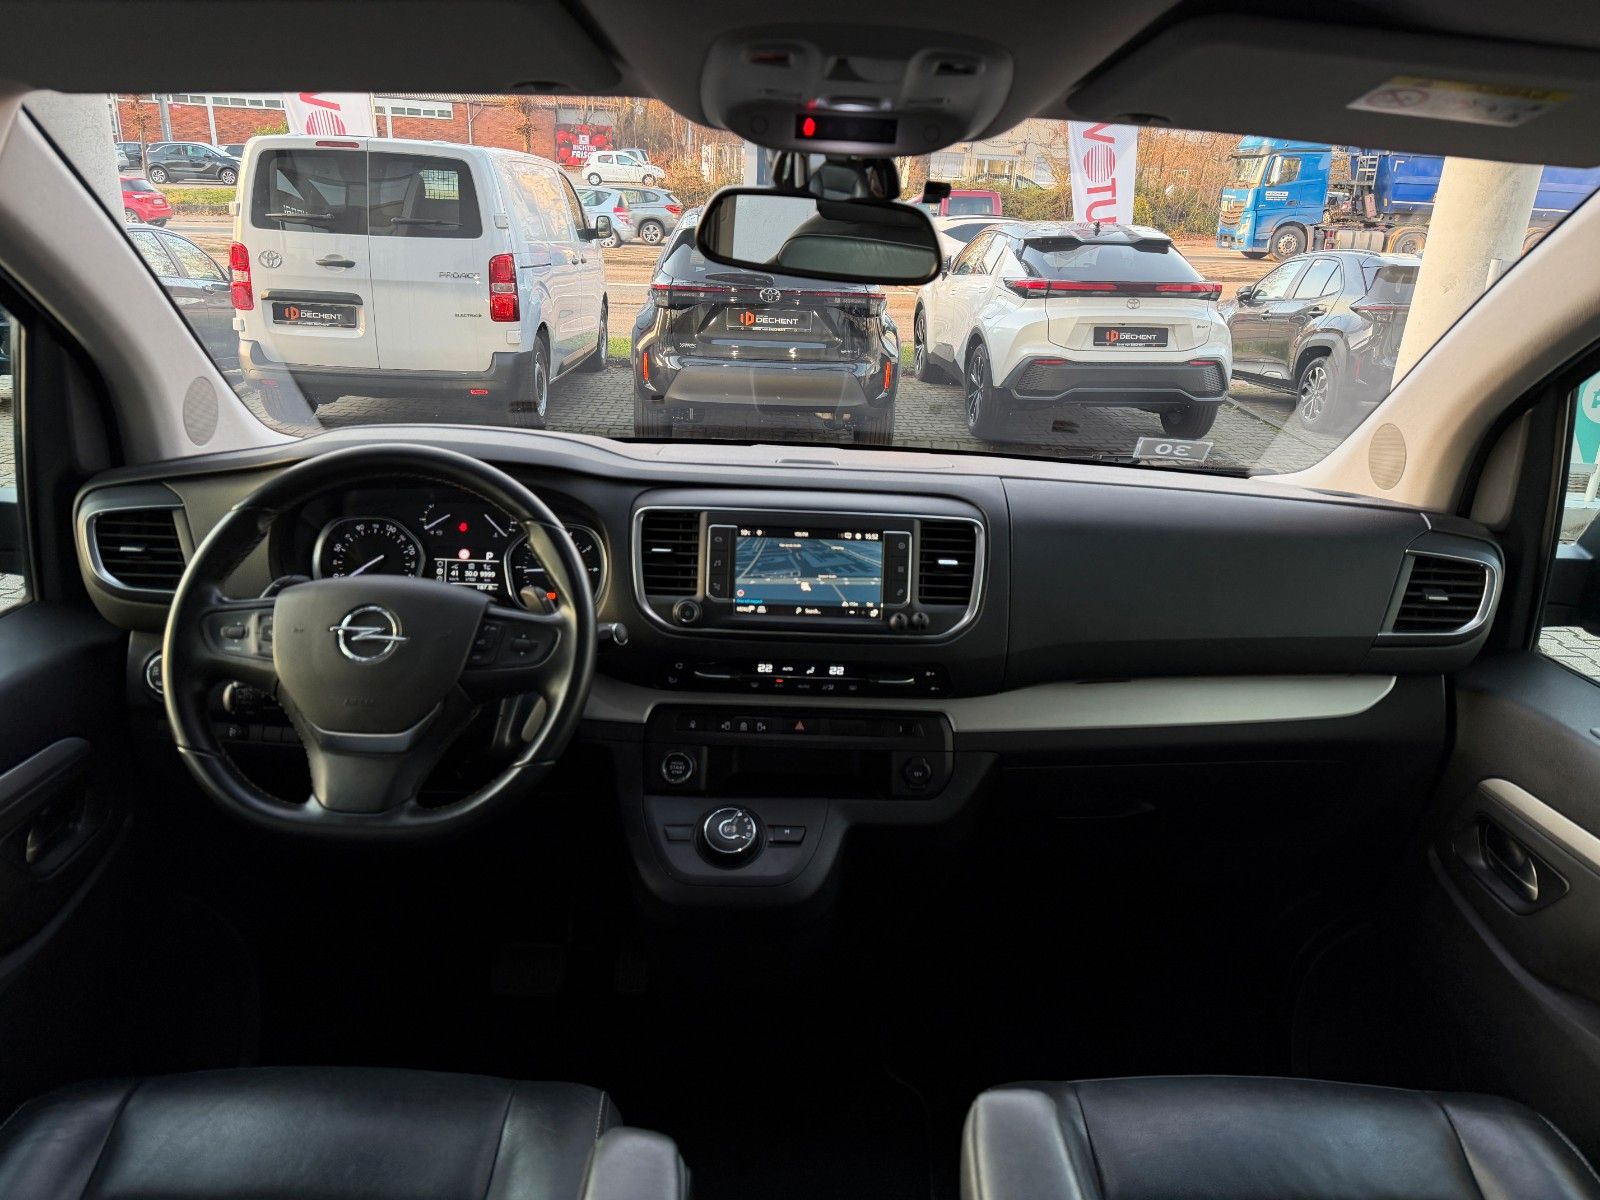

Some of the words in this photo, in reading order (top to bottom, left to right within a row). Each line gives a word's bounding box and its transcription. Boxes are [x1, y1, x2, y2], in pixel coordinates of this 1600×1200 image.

[300, 310, 342, 319] DECHENT
[756, 317, 799, 325] DECHENT
[486, 552, 494, 561] P
[757, 663, 773, 673] 22
[829, 666, 845, 676] 22
